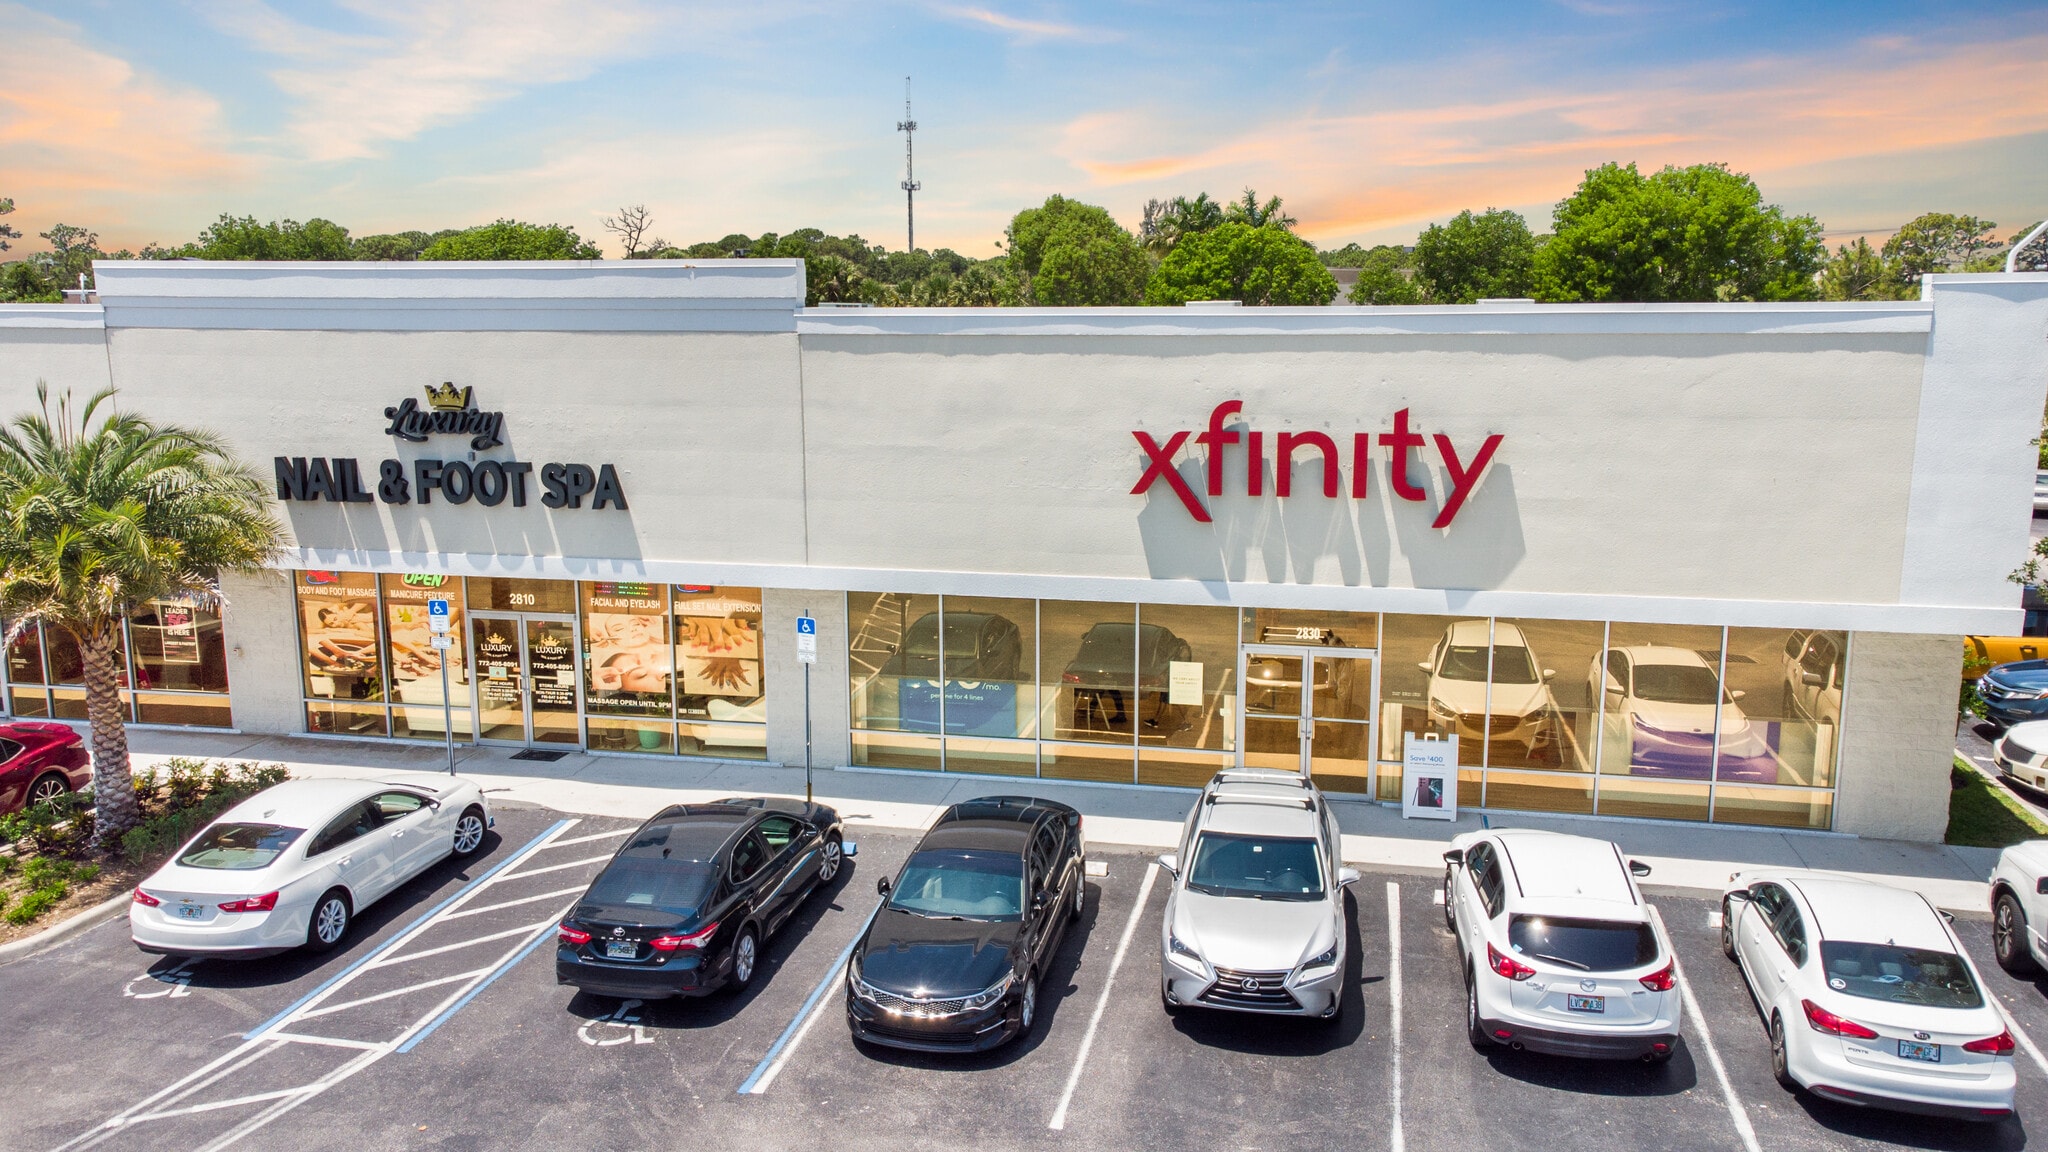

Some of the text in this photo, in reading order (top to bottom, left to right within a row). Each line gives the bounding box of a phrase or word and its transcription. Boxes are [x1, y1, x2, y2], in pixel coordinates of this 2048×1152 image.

[384, 397, 504, 451] Luxury
[1129, 400, 1505, 528] xfinity
[274, 456, 629, 510] NAIL & FOOT SPA
[404, 573, 442, 586] OPEN
[297, 586, 377, 597] BODY AND FOOT MASSAGE
[390, 590, 455, 600] MANICURE PEDICURE
[509, 593, 535, 605] 2810
[591, 598, 660, 608] FACIAL AND EYELASH
[674, 601, 762, 612] FULL SET NAIL EXTENSION
[168, 614, 188, 626] 5G
[1296, 627, 1320, 640] 2830
[480, 644, 512, 652] LUXURY
[536, 646, 568, 654] LUXURY
[982, 683, 1001, 691] /mo.
